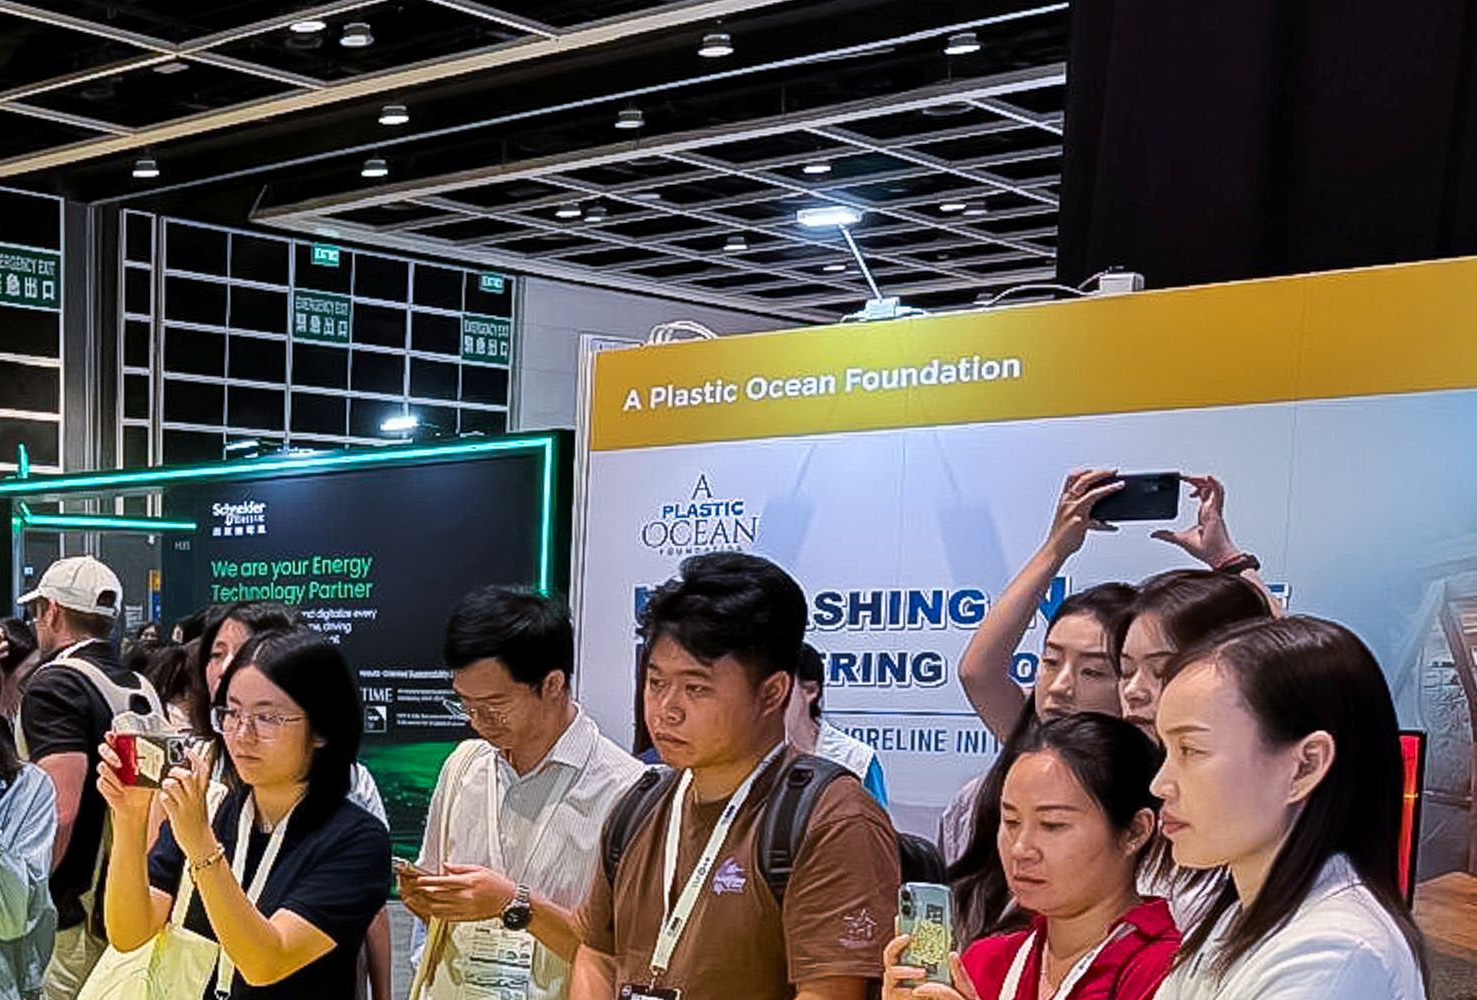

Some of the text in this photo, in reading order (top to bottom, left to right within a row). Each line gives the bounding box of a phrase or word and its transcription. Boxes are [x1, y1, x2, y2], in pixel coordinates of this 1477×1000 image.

[623, 356, 1021, 411] A Plastic Ocean Foundation
[692, 474, 712, 499] A
[662, 501, 744, 518] PLASTIC
[642, 517, 758, 548] OCEAN
[211, 556, 373, 581] We are your Energy
[211, 581, 373, 605] Technology Partner
[806, 589, 986, 627] SHING
[822, 652, 942, 684] RING
